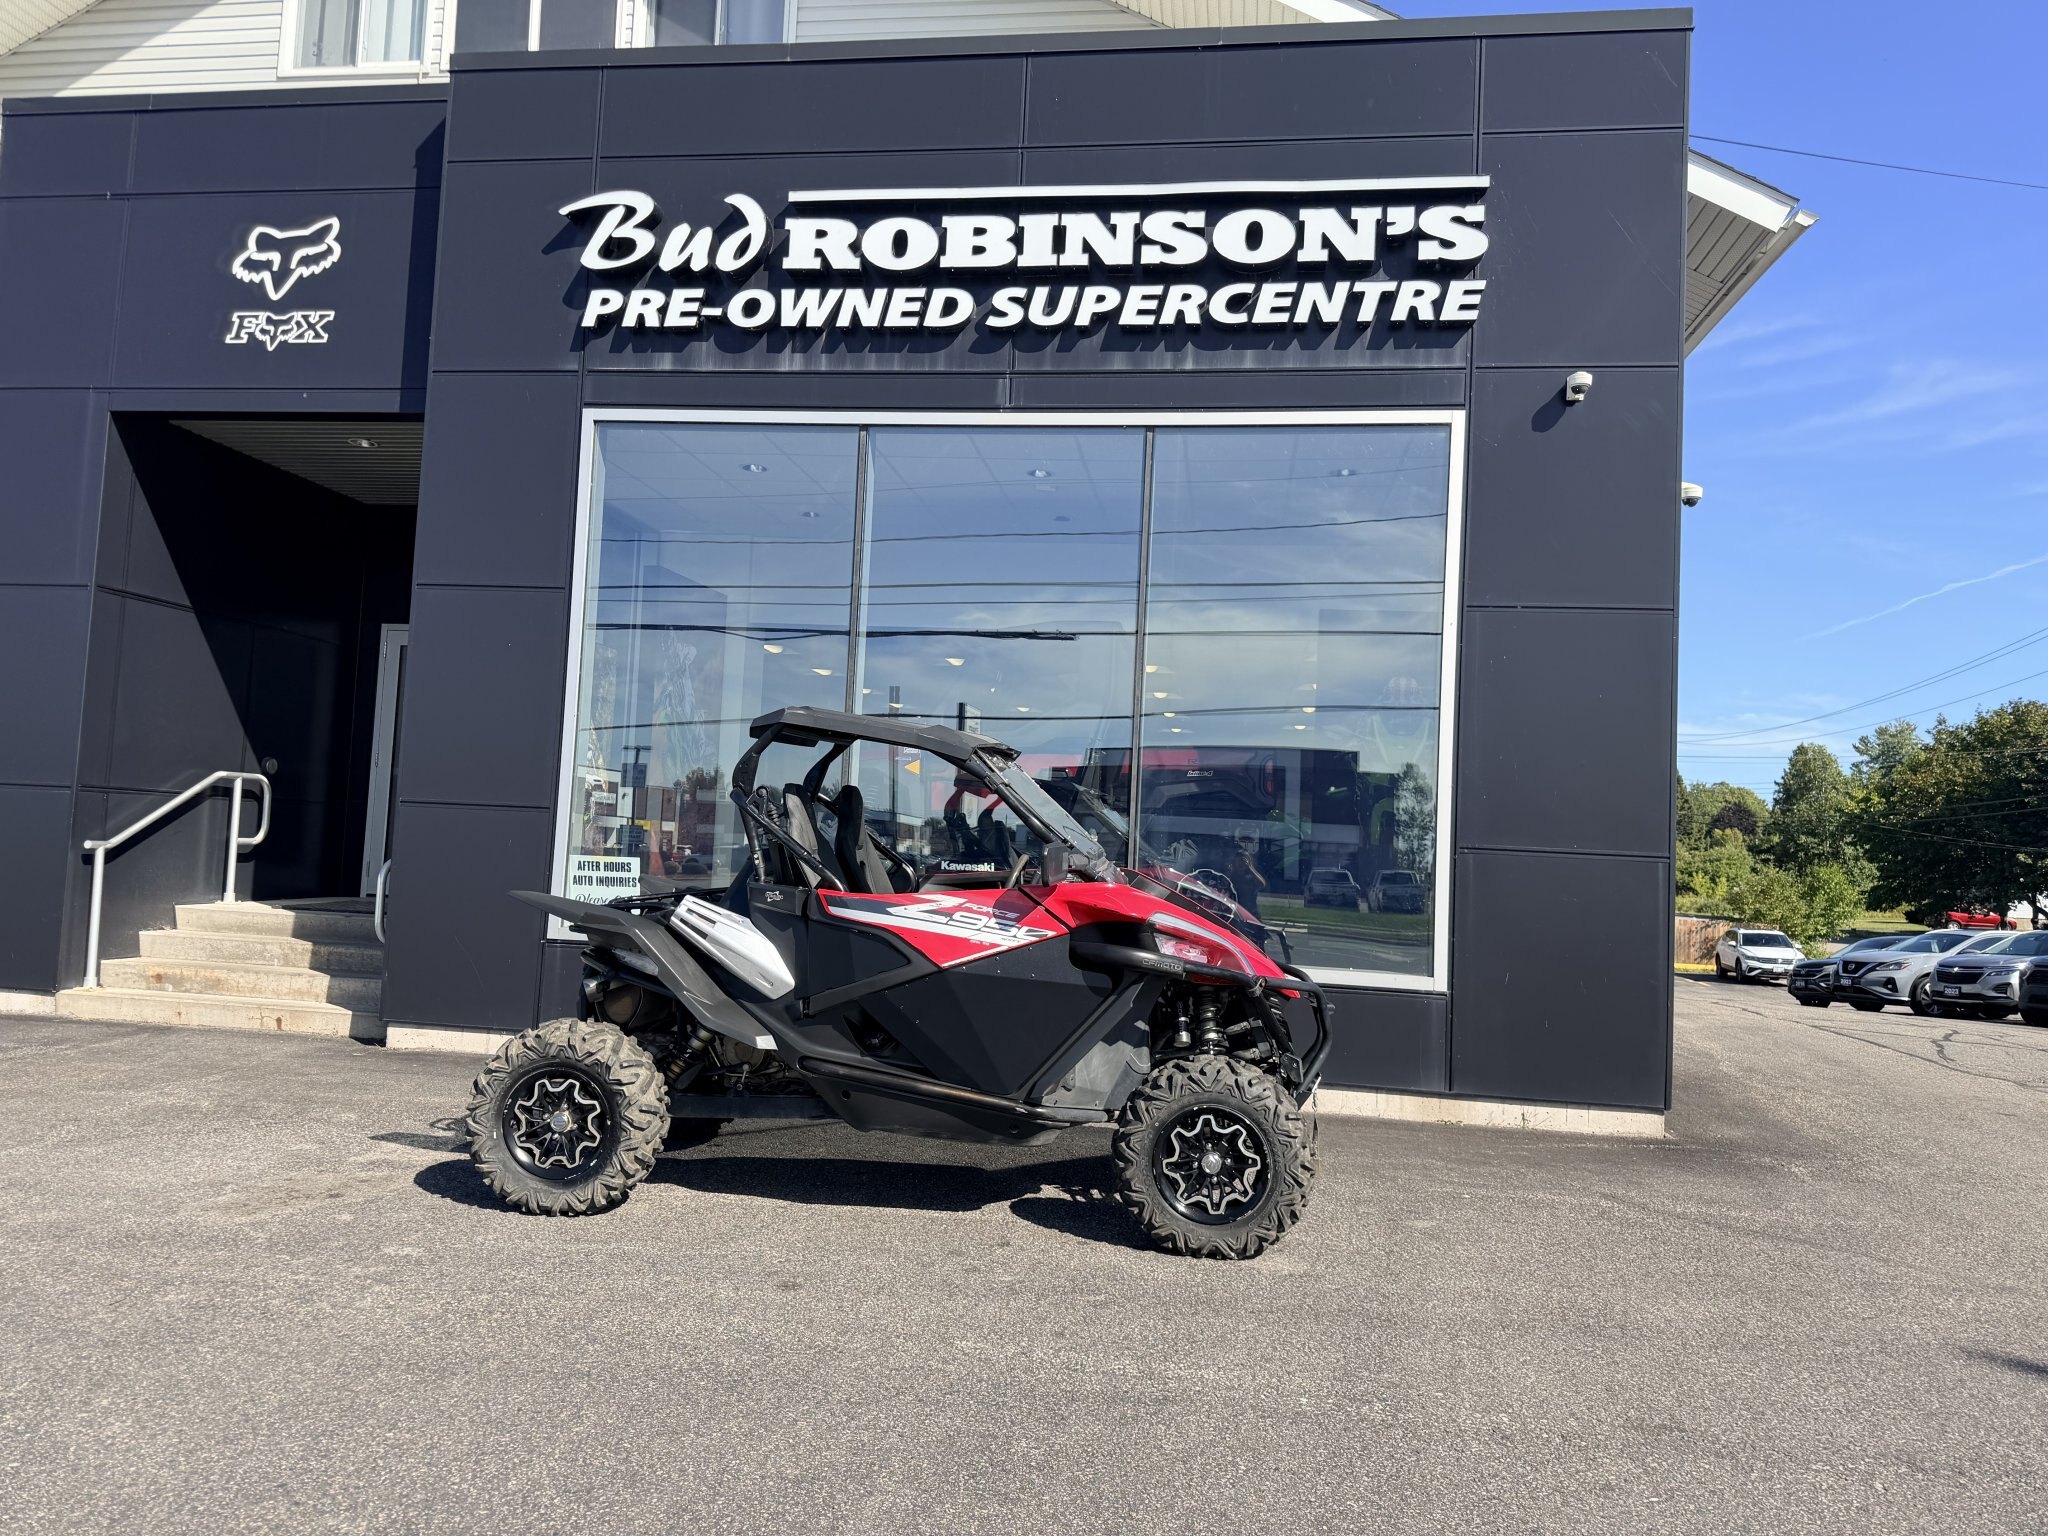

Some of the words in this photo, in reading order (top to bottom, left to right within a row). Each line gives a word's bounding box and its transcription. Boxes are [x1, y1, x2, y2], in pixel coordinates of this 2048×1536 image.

[559, 190, 770, 272] Bud
[782, 205, 1489, 271] ROBINSON'S
[581, 288, 974, 328] PRE-OWNED
[984, 280, 1487, 328] SUPERCENTRE
[577, 860, 601, 872] AFTER
[603, 861, 632, 873] HOURS
[940, 860, 995, 872] Kawasaki
[572, 874, 593, 886] AUTO
[595, 875, 637, 888] INQUIRIES
[961, 902, 1021, 919] FORCE
